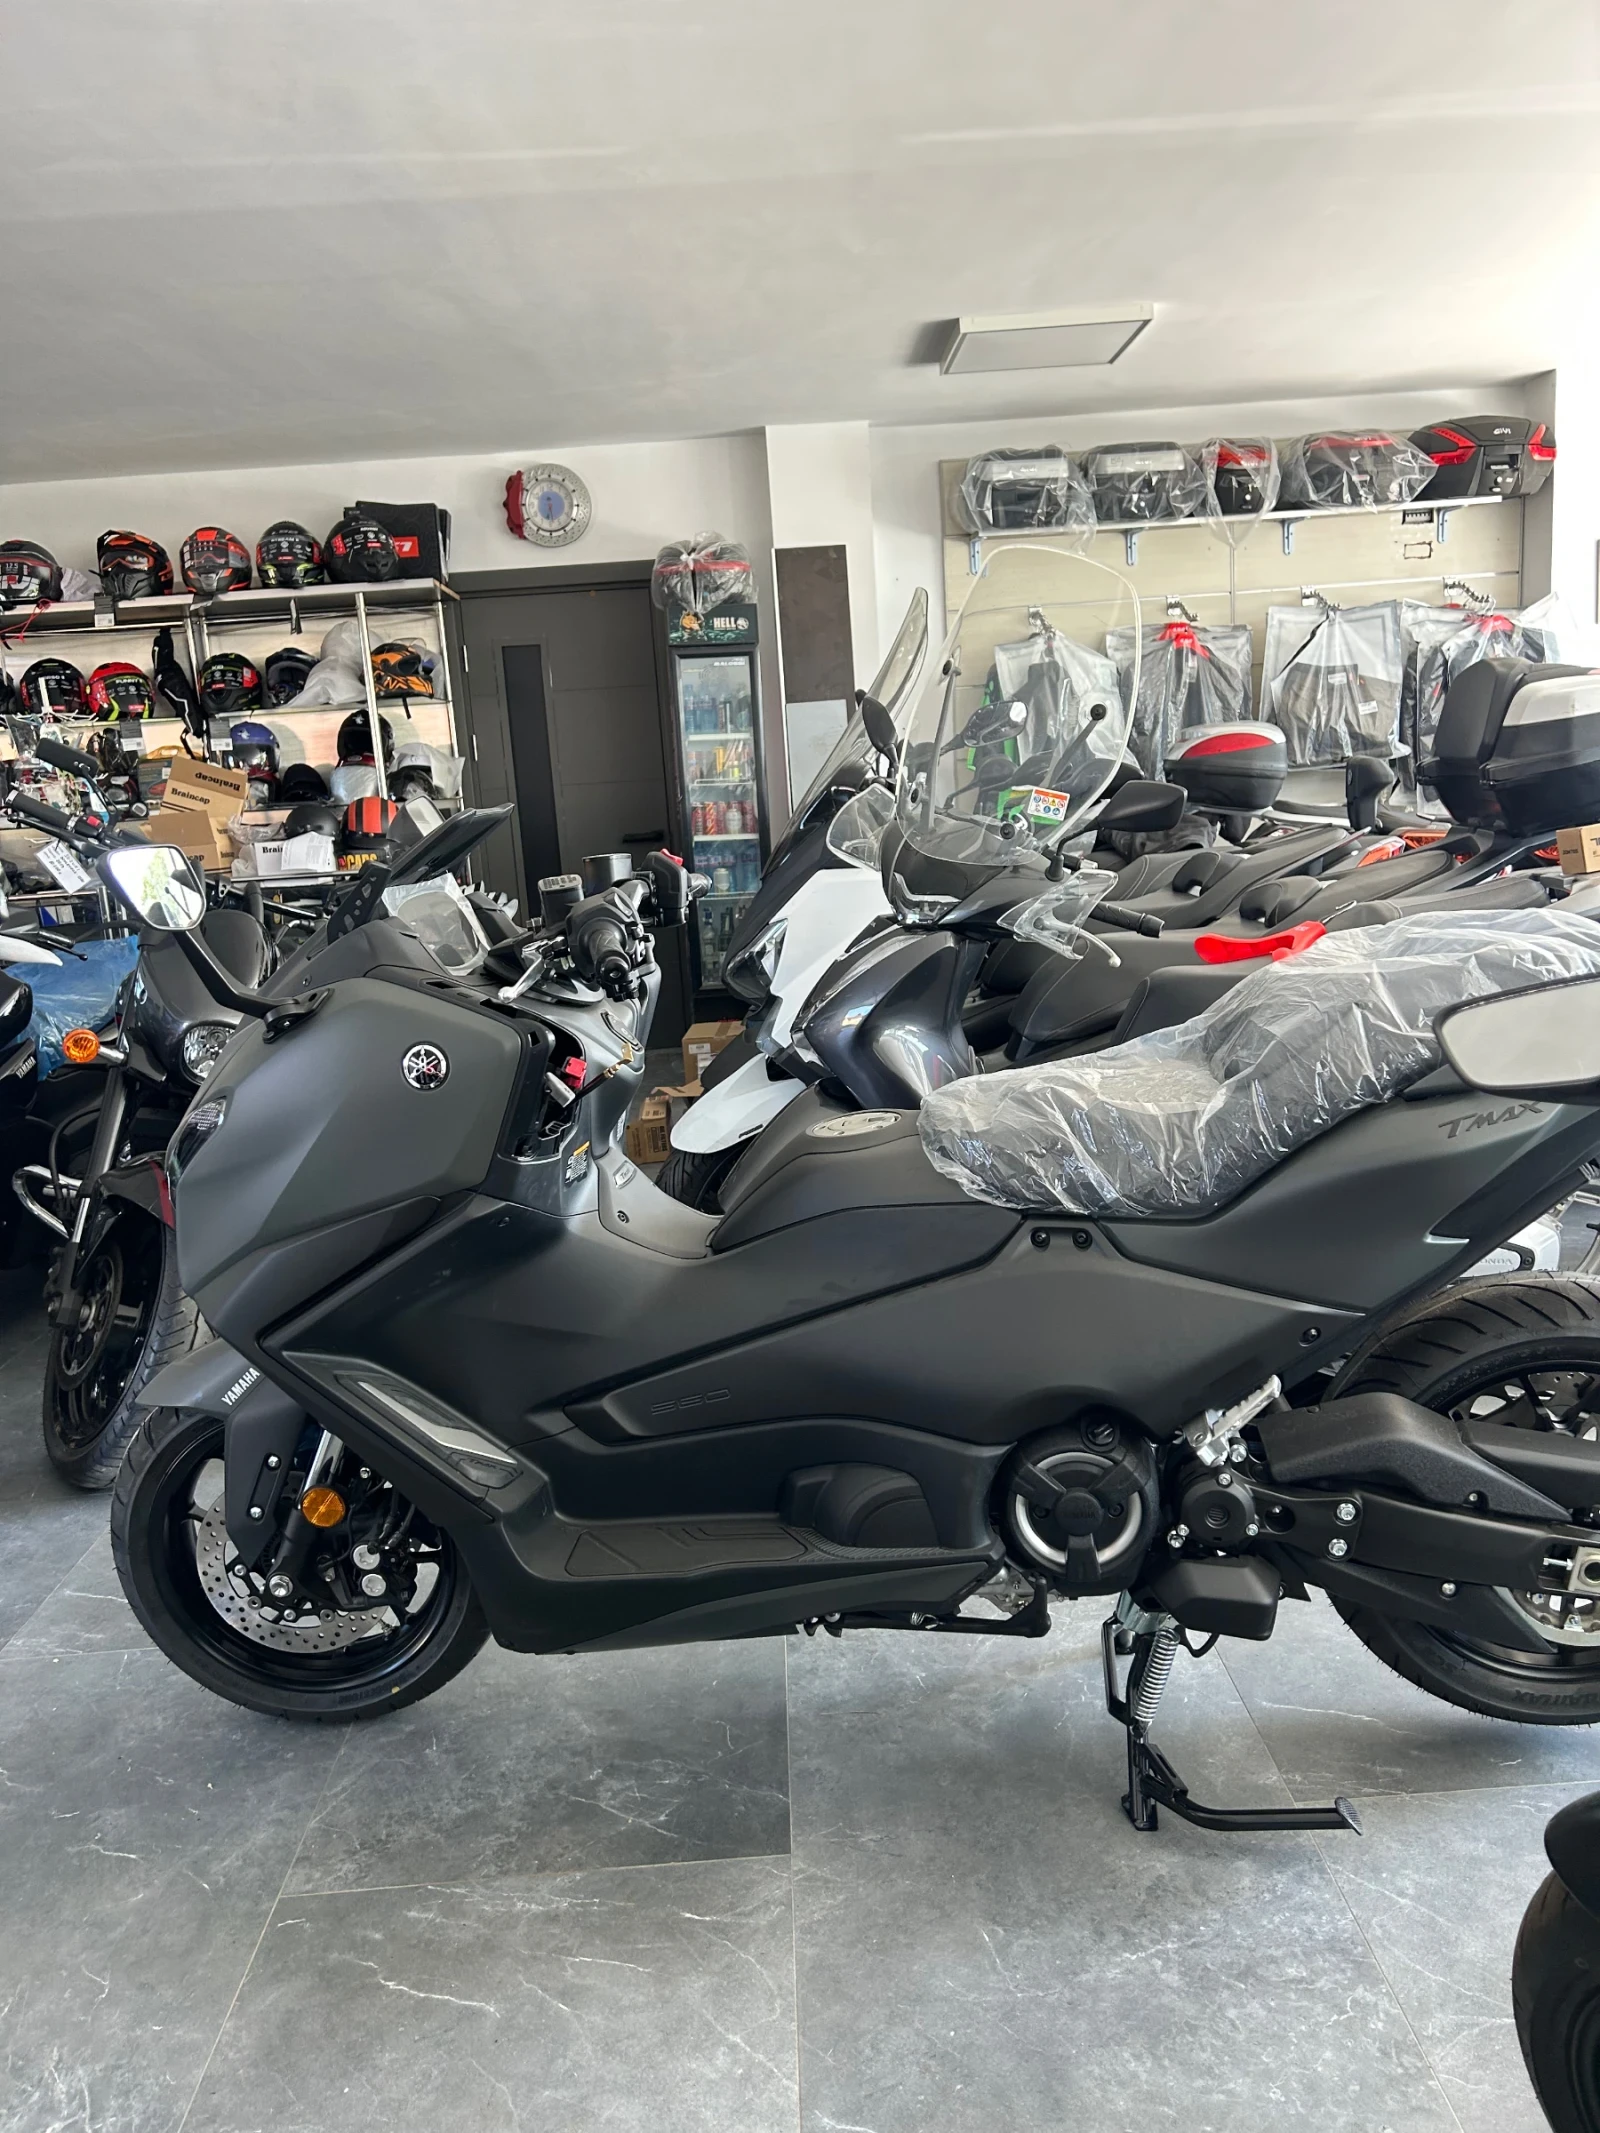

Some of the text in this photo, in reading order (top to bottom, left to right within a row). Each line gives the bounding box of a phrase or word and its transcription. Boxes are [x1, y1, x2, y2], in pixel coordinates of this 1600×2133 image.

[1493, 427, 1512, 435] GIVI
[713, 616, 737, 628] HELL
[195, 771, 241, 792] Braincap
[171, 787, 211, 805] Braincap
[15, 1055, 37, 1079] YAMAHA
[1438, 1100, 1545, 1139] TMAX
[1480, 1258, 1514, 1266] ONDA
[220, 1367, 261, 1406] YAMAHA
[651, 1388, 731, 1416] 560
